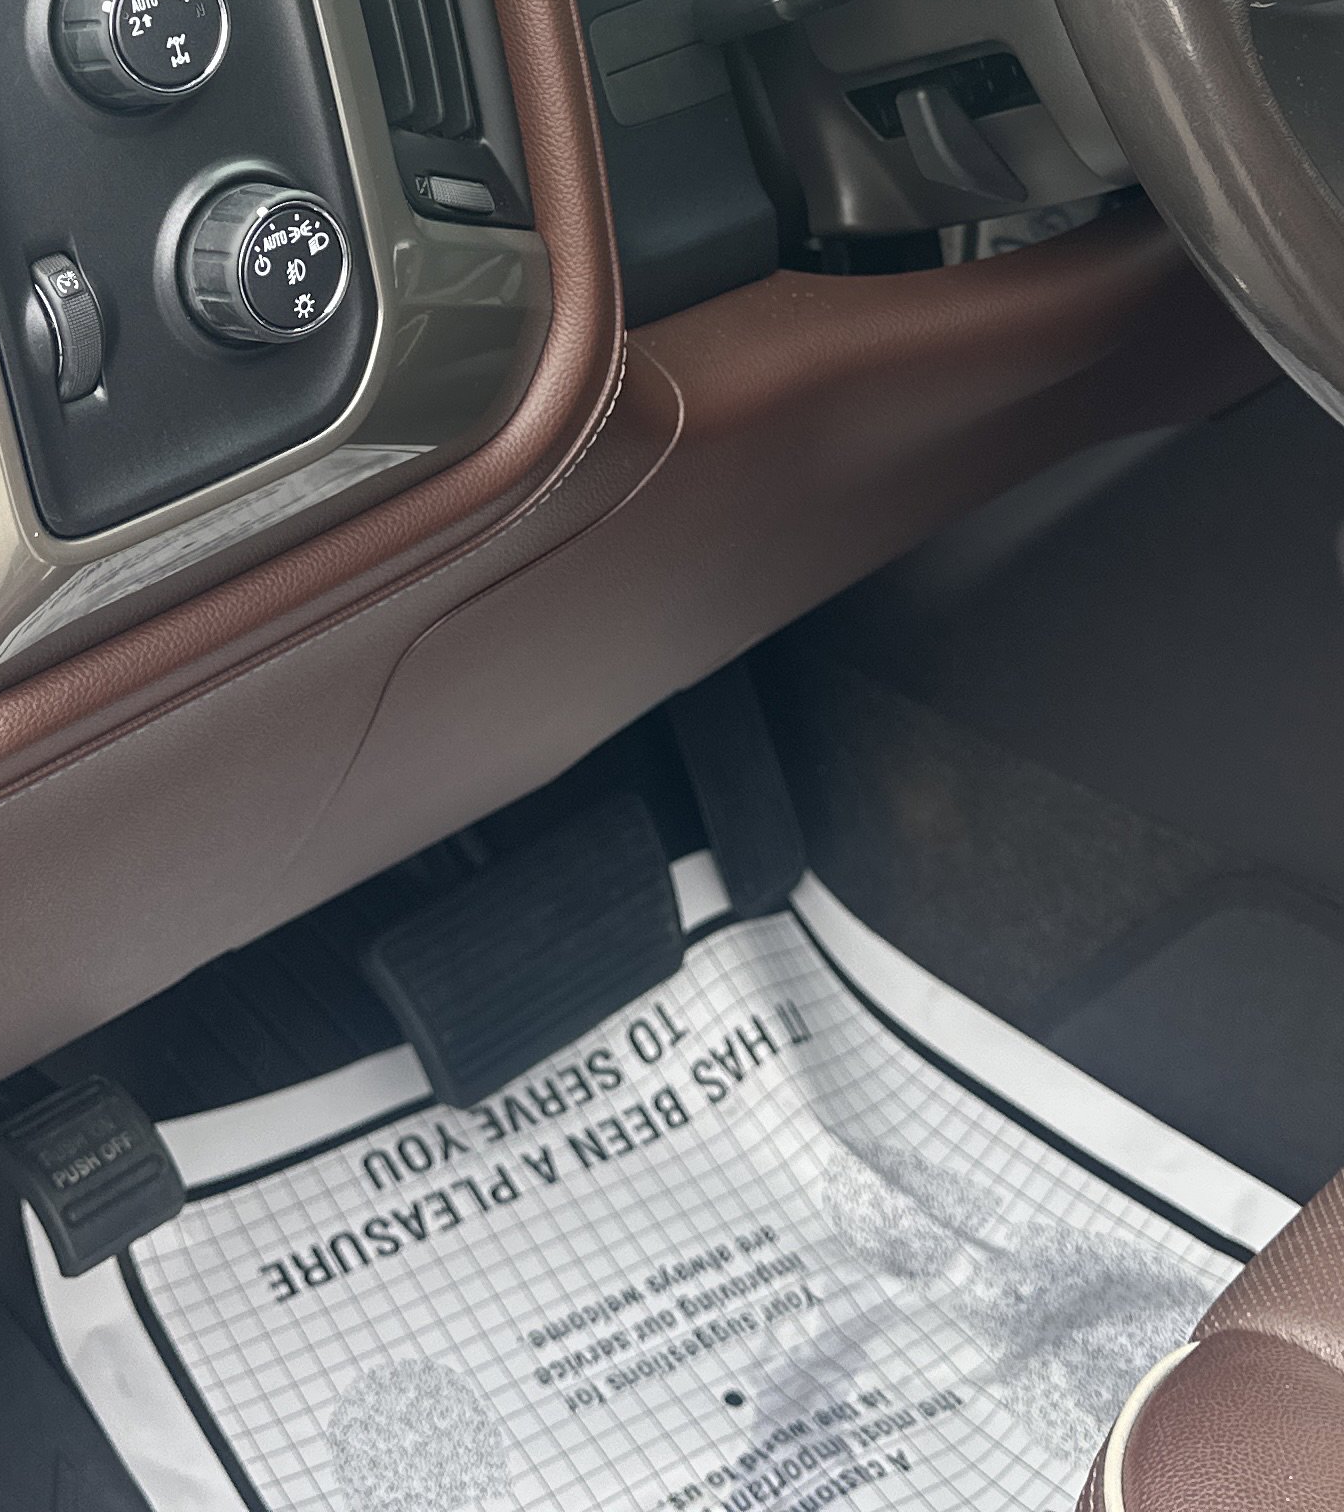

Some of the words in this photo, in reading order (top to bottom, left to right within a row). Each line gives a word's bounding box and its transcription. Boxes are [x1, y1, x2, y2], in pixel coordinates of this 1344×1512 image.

[263, 230, 287, 252] AUTO
[627, 1001, 689, 1065] TO
[693, 1013, 780, 1103] HAS
[472, 1051, 624, 1143] SERVE
[572, 1088, 690, 1170] BEEN
[52, 1155, 102, 1188] PUSH
[100, 1132, 133, 1160] OFF
[362, 1124, 470, 1190] YOU
[528, 1145, 559, 1186] A
[260, 1161, 523, 1303] PLEASURE
[735, 1224, 779, 1253] are
[644, 1243, 734, 1294] always
[676, 1251, 808, 1319] improving
[634, 1308, 677, 1342] our
[762, 1287, 824, 1324] Your
[534, 1331, 632, 1386] service
[606, 1310, 756, 1392] suggestions
[566, 1382, 605, 1413] for
[813, 1399, 862, 1429] the
[918, 1388, 964, 1418] the
[854, 1407, 917, 1449] most
[705, 1464, 737, 1487] to
